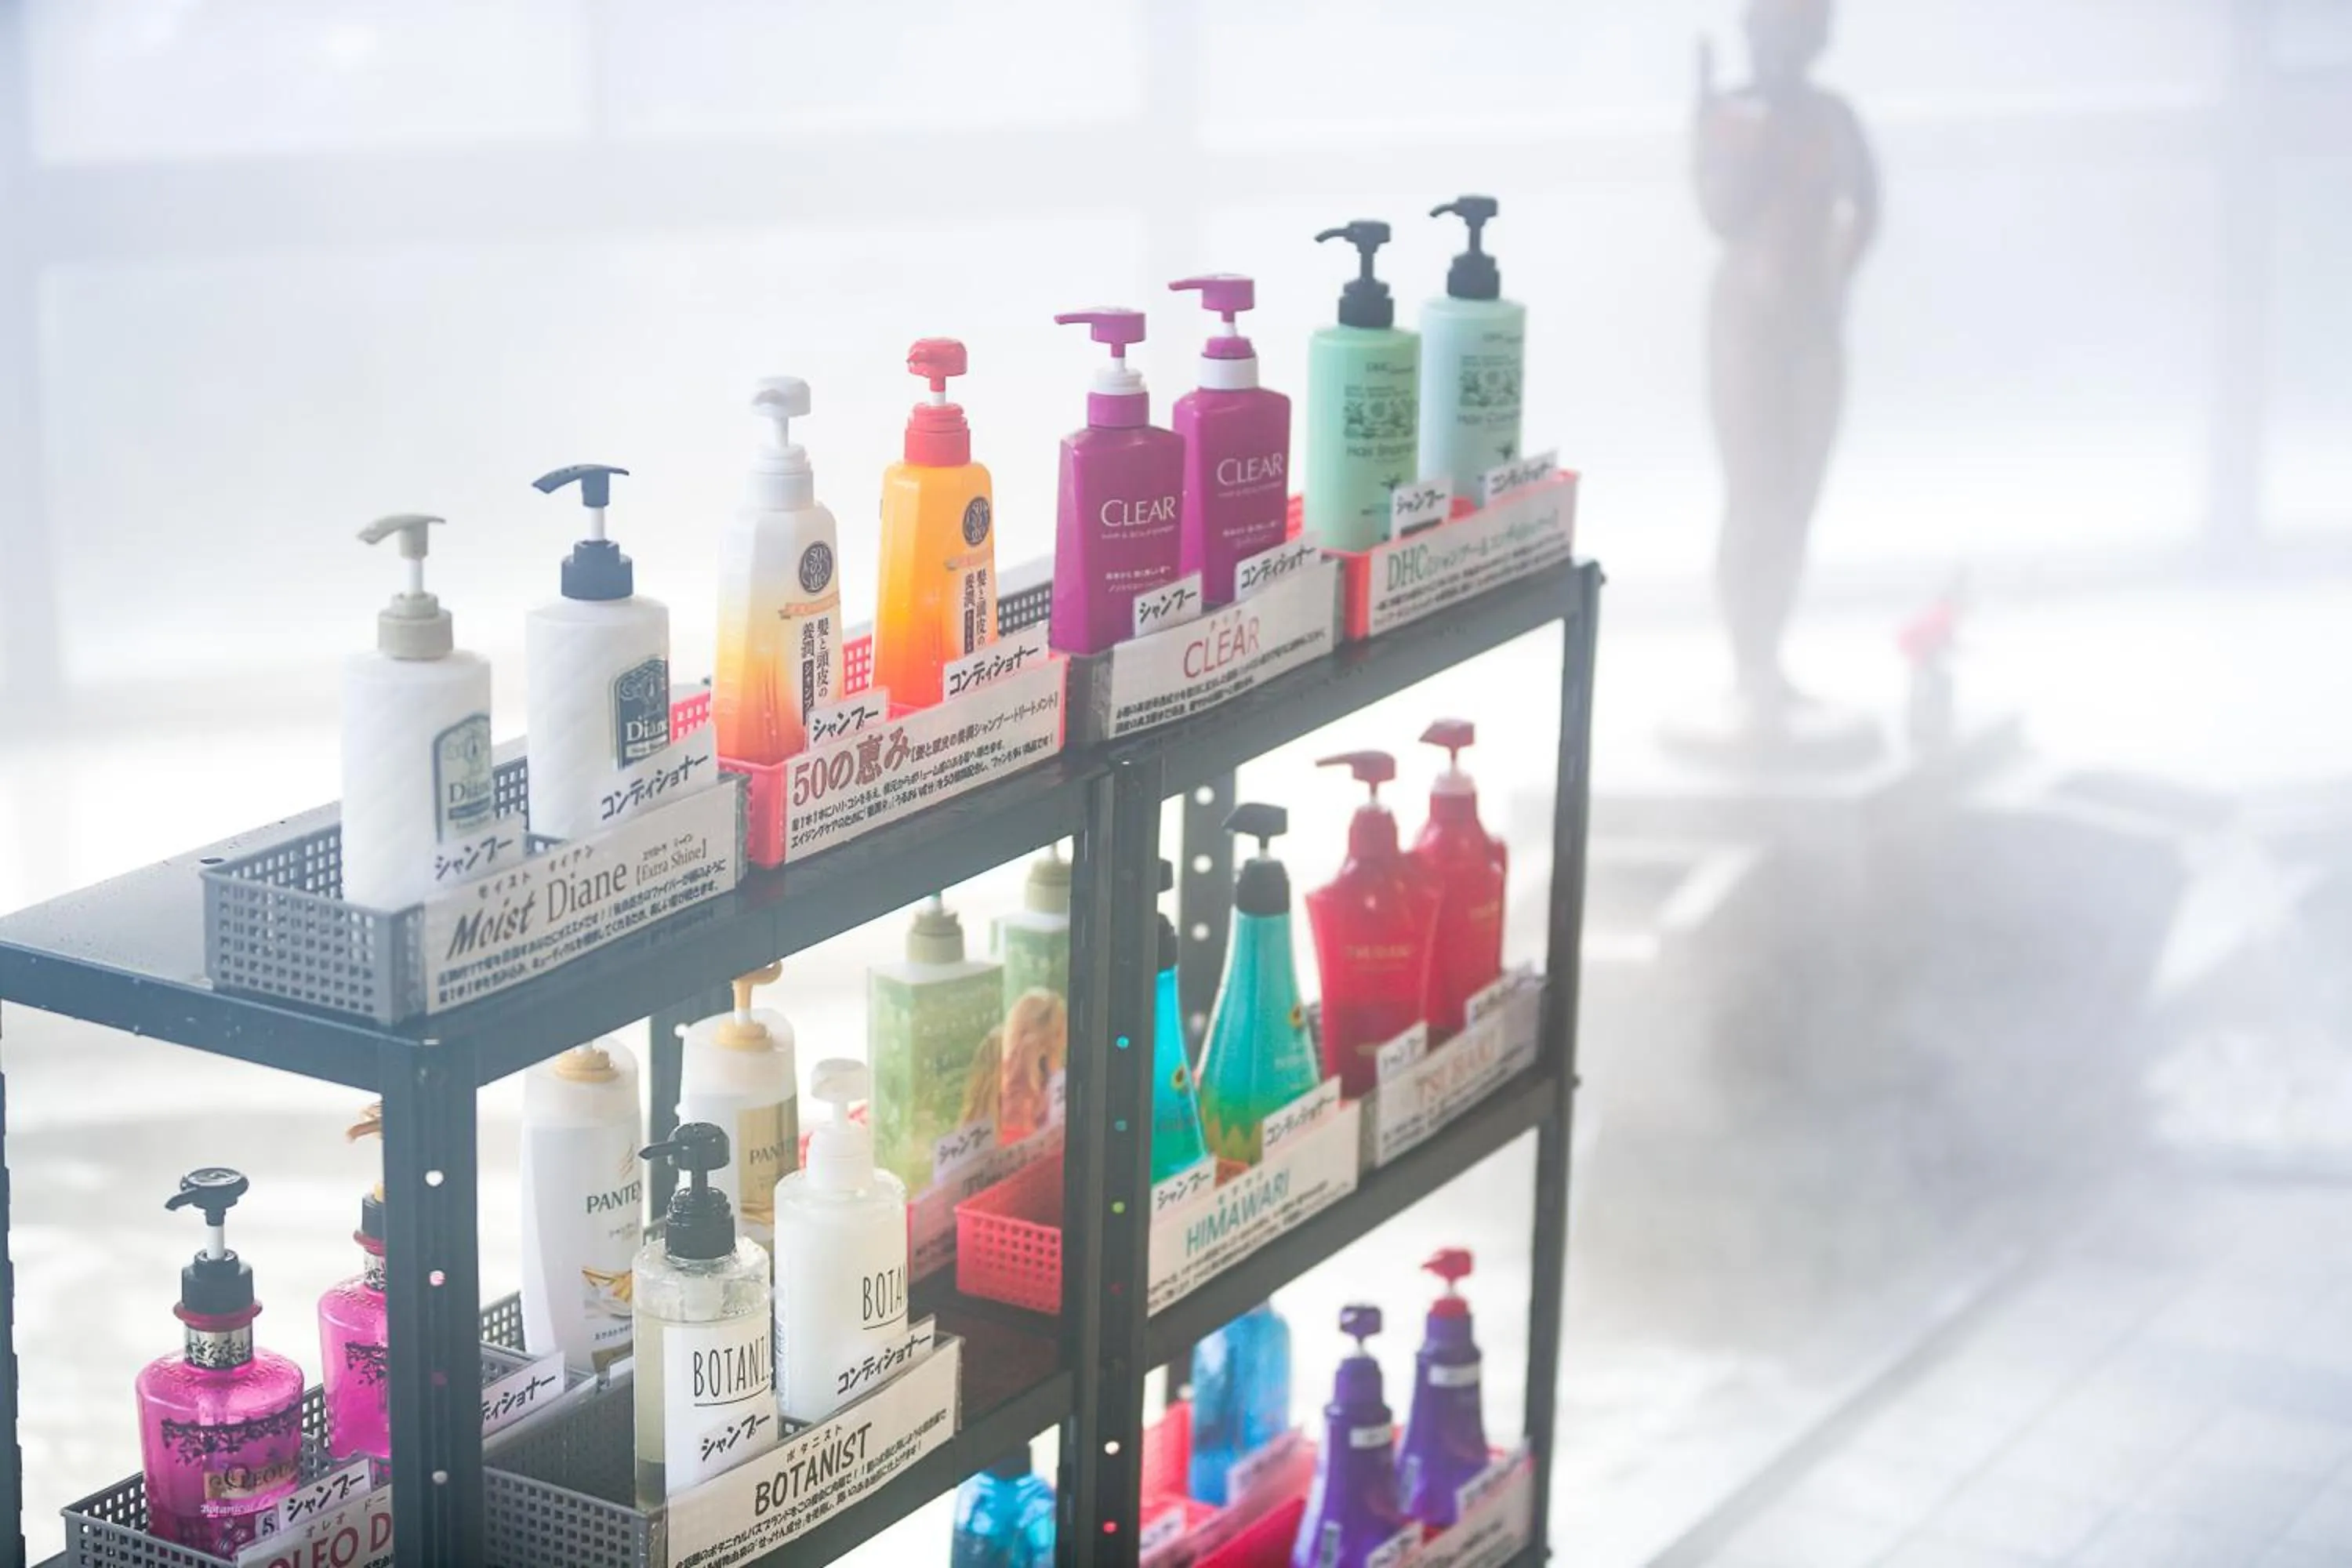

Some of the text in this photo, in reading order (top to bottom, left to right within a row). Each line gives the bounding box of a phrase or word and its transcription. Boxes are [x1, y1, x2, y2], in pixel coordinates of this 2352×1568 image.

[1217, 452, 1283, 486] CLEAR
[1101, 496, 1175, 527] CLEAR
[949, 645, 1039, 695] コンディショナー
[1182, 616, 1260, 678] CLEAR
[813, 706, 879, 742] シャンプー
[602, 754, 708, 820] コンディショナー
[793, 727, 911, 807] 50の恵み
[436, 836, 514, 880] シャンプー
[445, 891, 536, 960] Moist
[547, 862, 627, 924] Diane
[693, 1335, 769, 1398] BOTANI
[837, 1334, 931, 1395] コンディショナー
[702, 1414, 771, 1461] シャンプー
[786, 1424, 842, 1463] ボタニスト
[754, 1422, 873, 1516] BOTANIST
[287, 1474, 365, 1522] シャンプー
